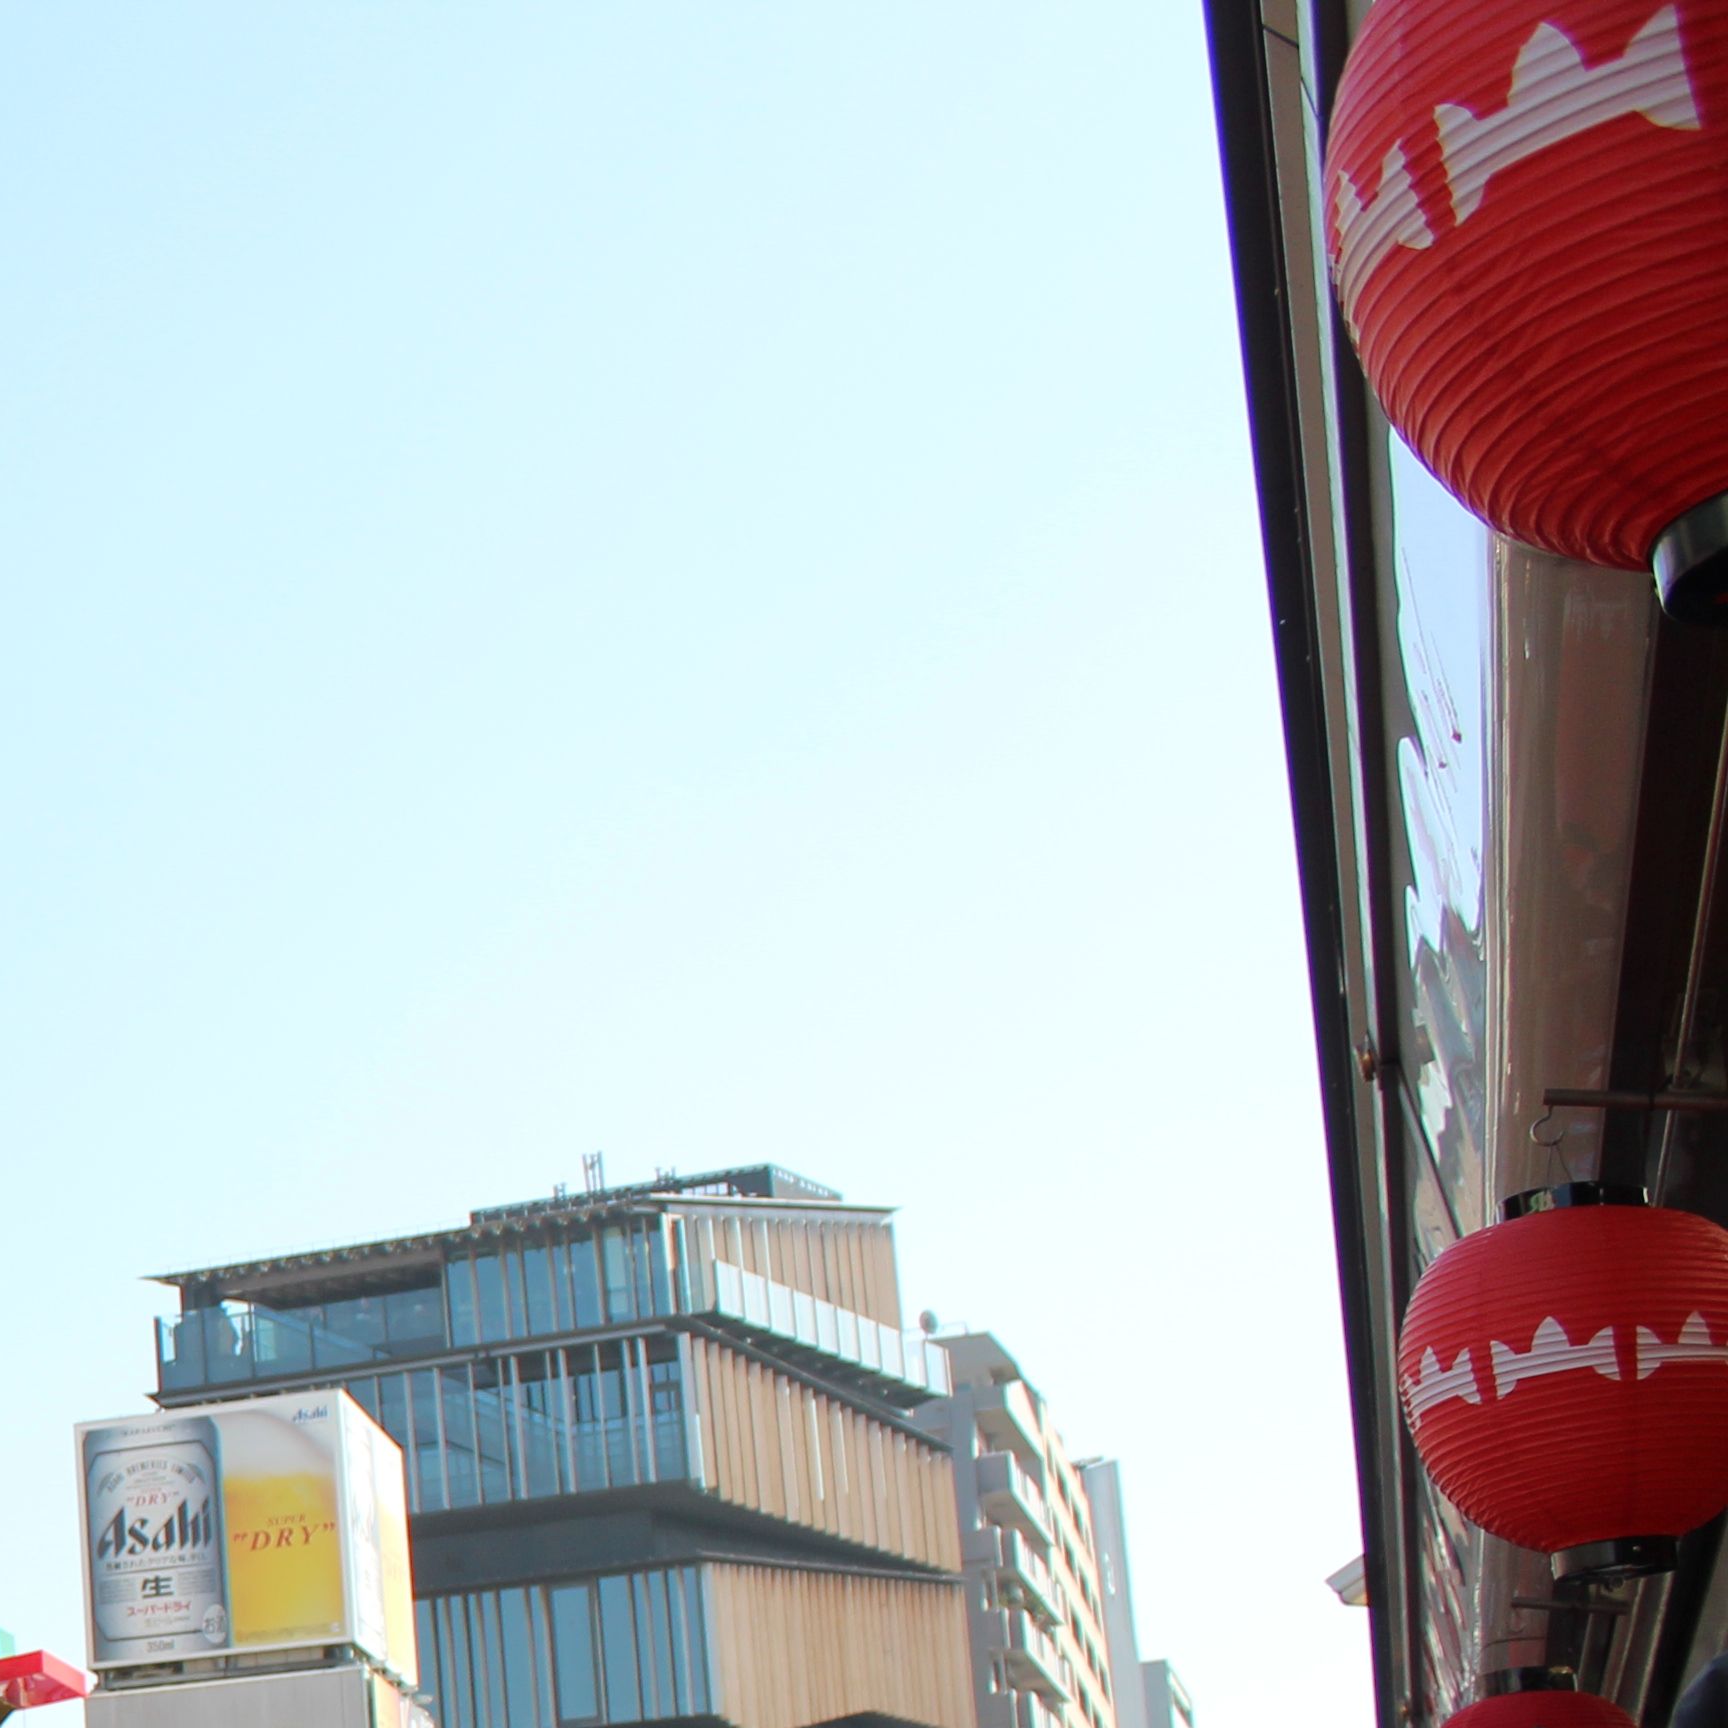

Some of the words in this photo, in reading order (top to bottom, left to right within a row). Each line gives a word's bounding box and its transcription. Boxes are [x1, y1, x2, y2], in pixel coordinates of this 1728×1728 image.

[292, 1405, 329, 1423] Asahi
[97, 1497, 213, 1559] Asahi
[266, 1513, 307, 1528] SUPER
[141, 1575, 175, 1599] 生
[127, 1601, 192, 1617] スーパードライ
